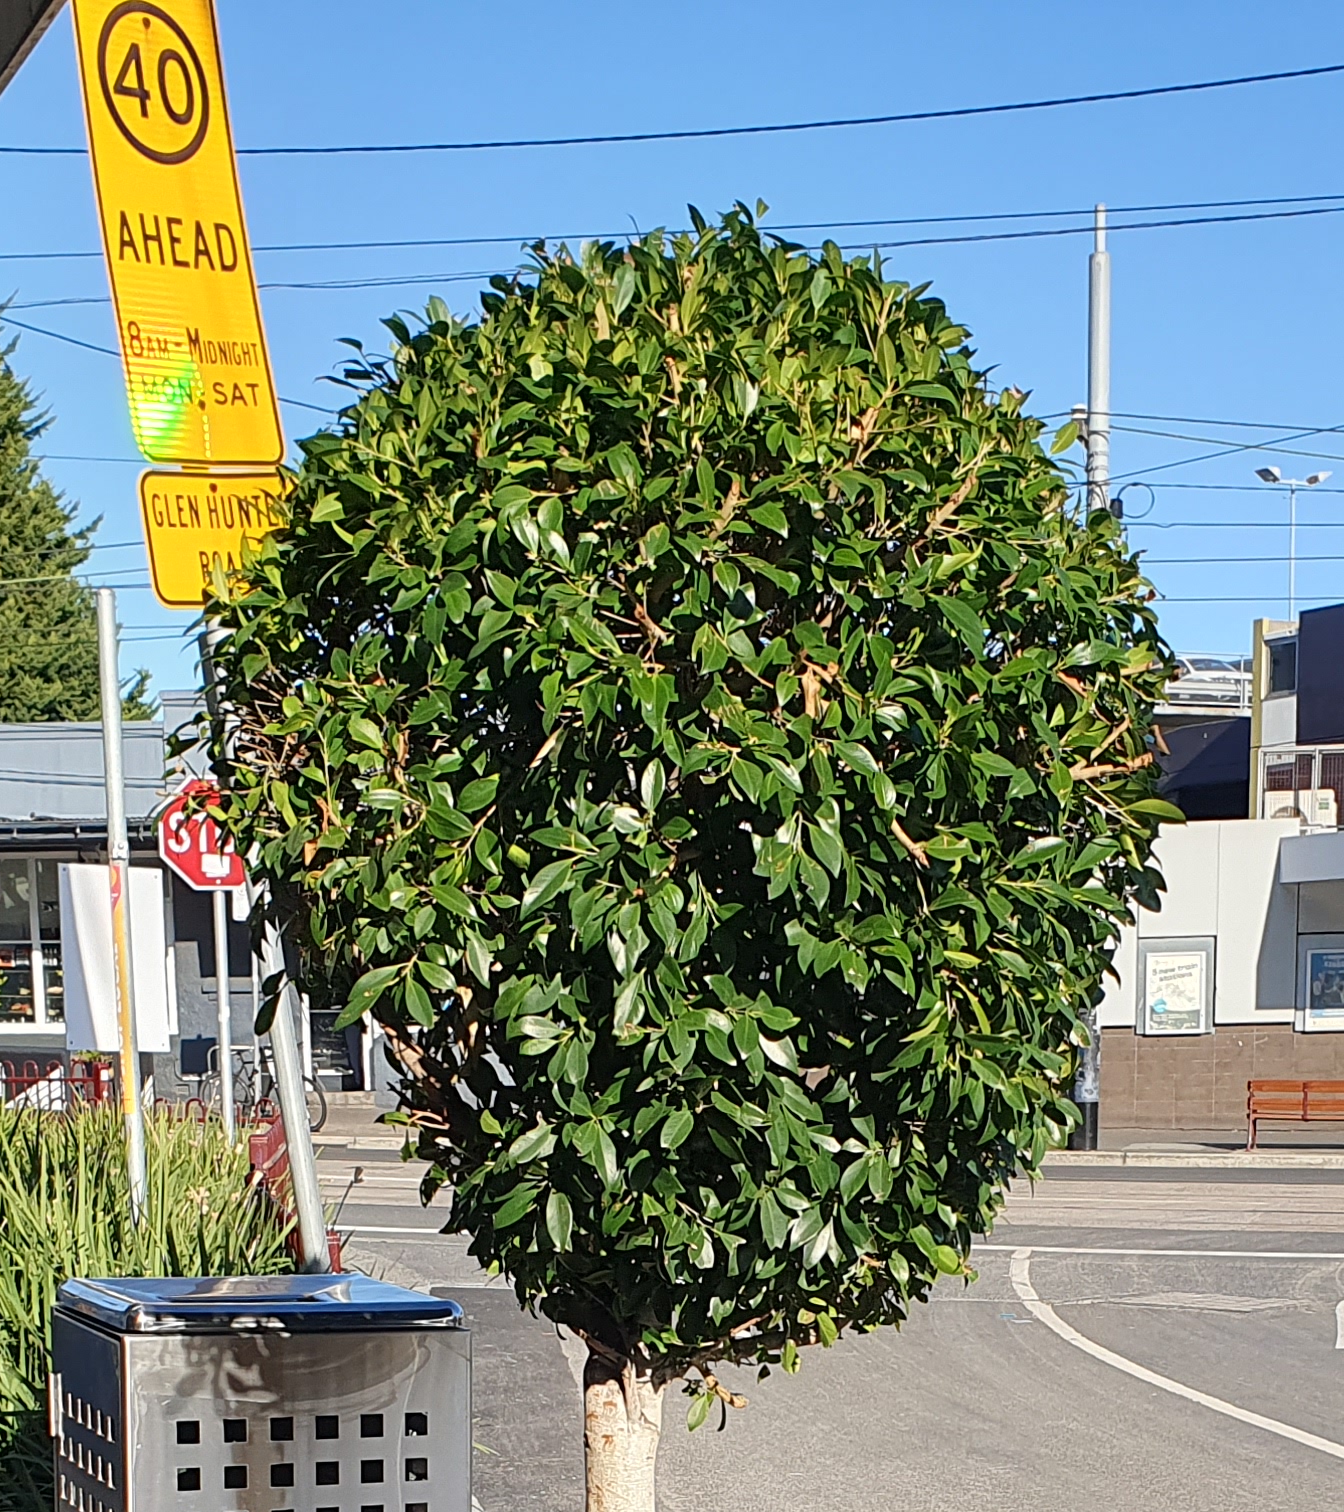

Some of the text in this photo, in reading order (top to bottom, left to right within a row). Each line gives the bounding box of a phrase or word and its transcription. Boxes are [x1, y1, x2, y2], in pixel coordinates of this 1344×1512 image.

[113, 42, 194, 125] 40
[118, 209, 239, 273] AHEAD
[212, 381, 260, 407] SAT
[151, 493, 201, 529] GLEN
